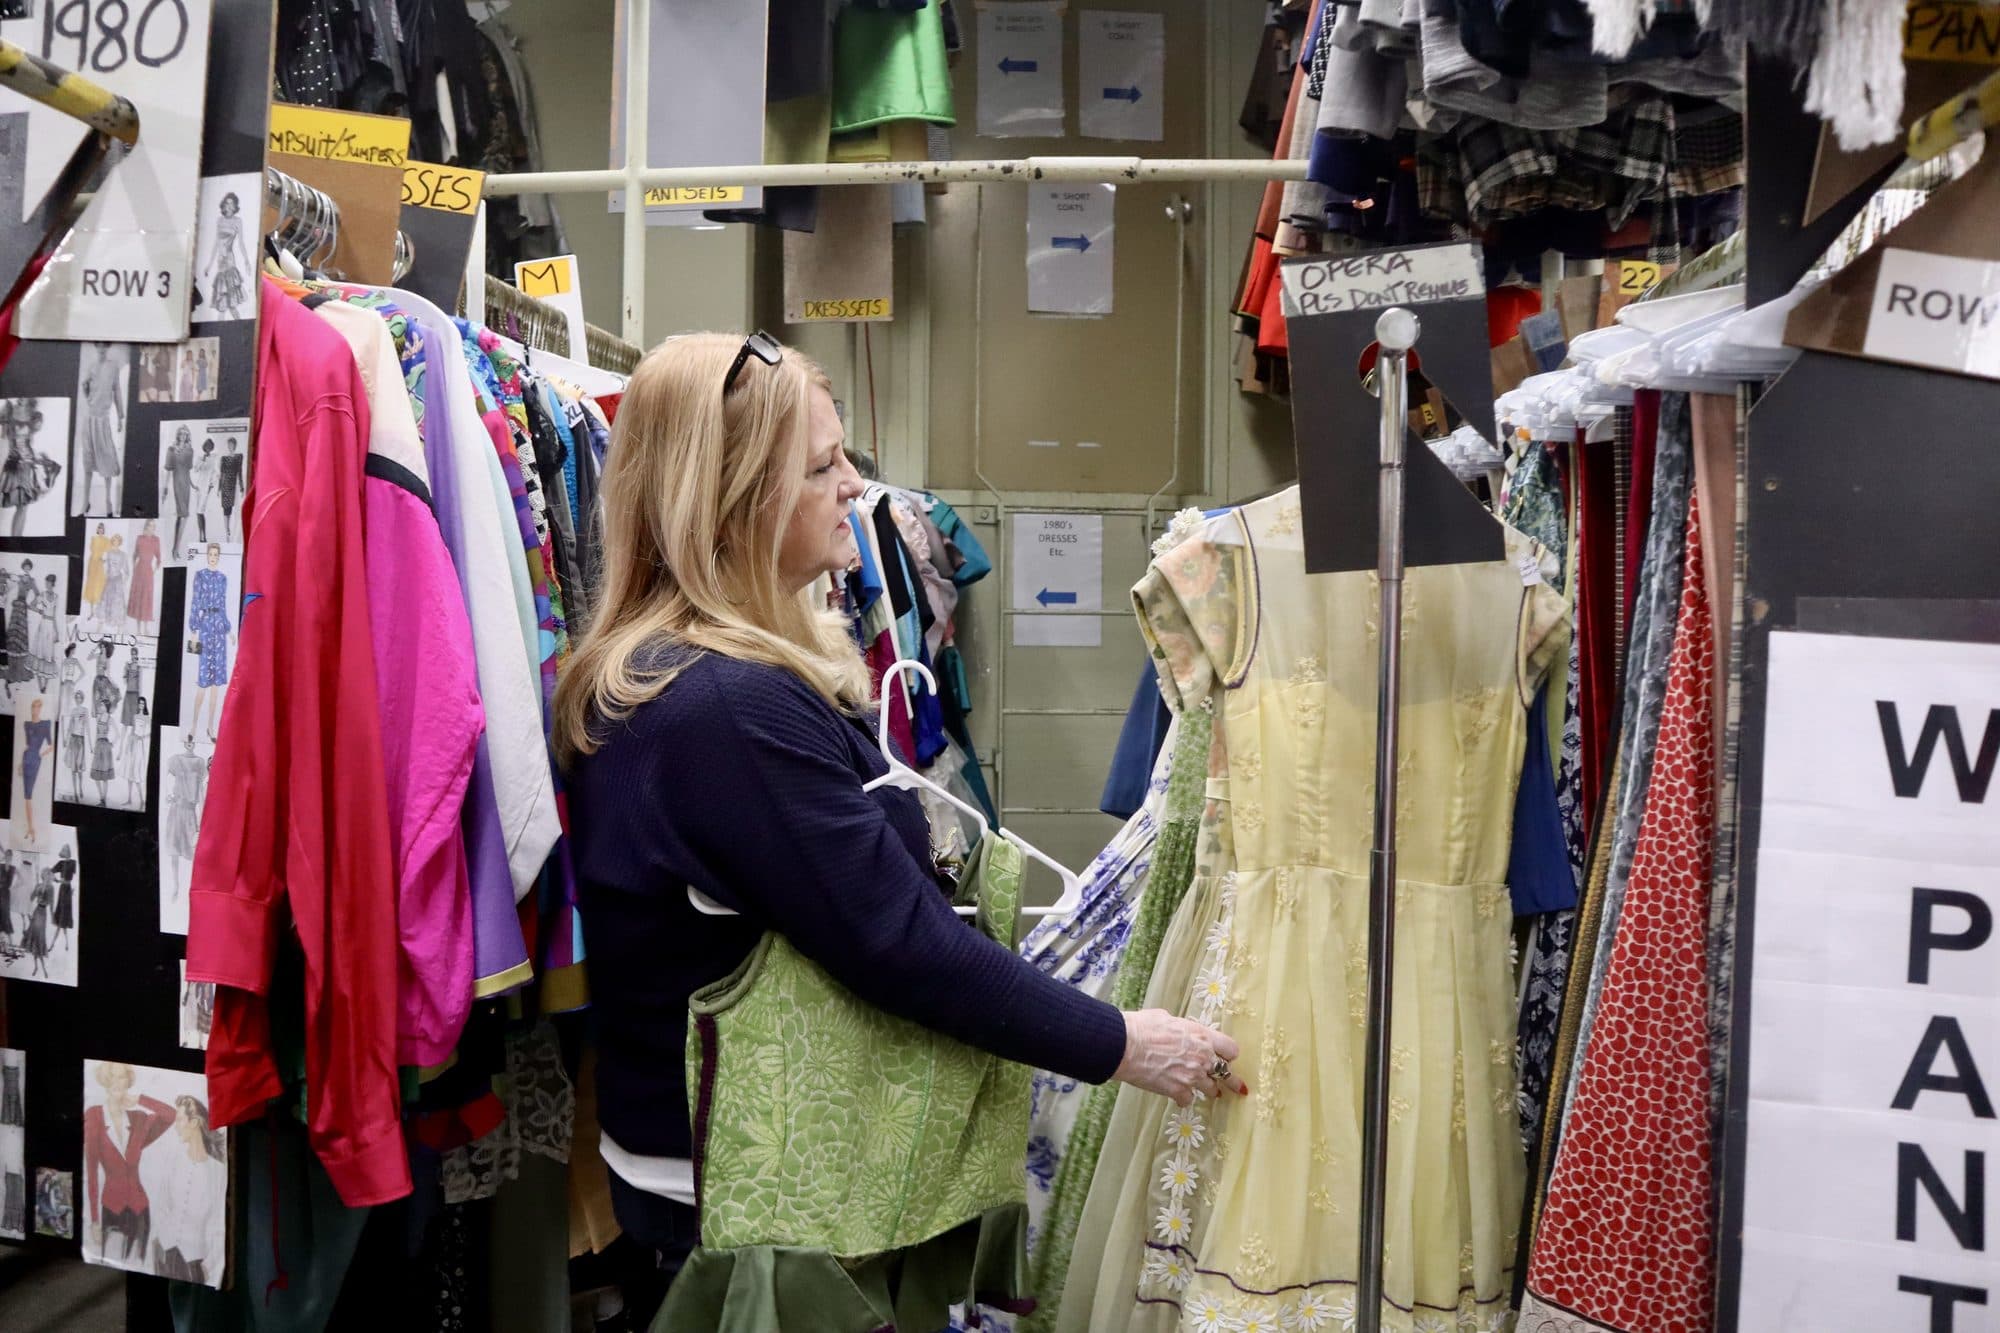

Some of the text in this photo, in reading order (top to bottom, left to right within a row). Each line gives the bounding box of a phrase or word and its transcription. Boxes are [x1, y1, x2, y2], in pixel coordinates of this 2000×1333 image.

[42, 0, 189, 72] 1980
[82, 269, 171, 299] ROW 3
[522, 263, 559, 294] M
[1301, 253, 1414, 290] OPERA
[1621, 267, 1656, 289] 22
[1038, 534, 1078, 544] DRESSES
[1875, 699, 2000, 804] W
